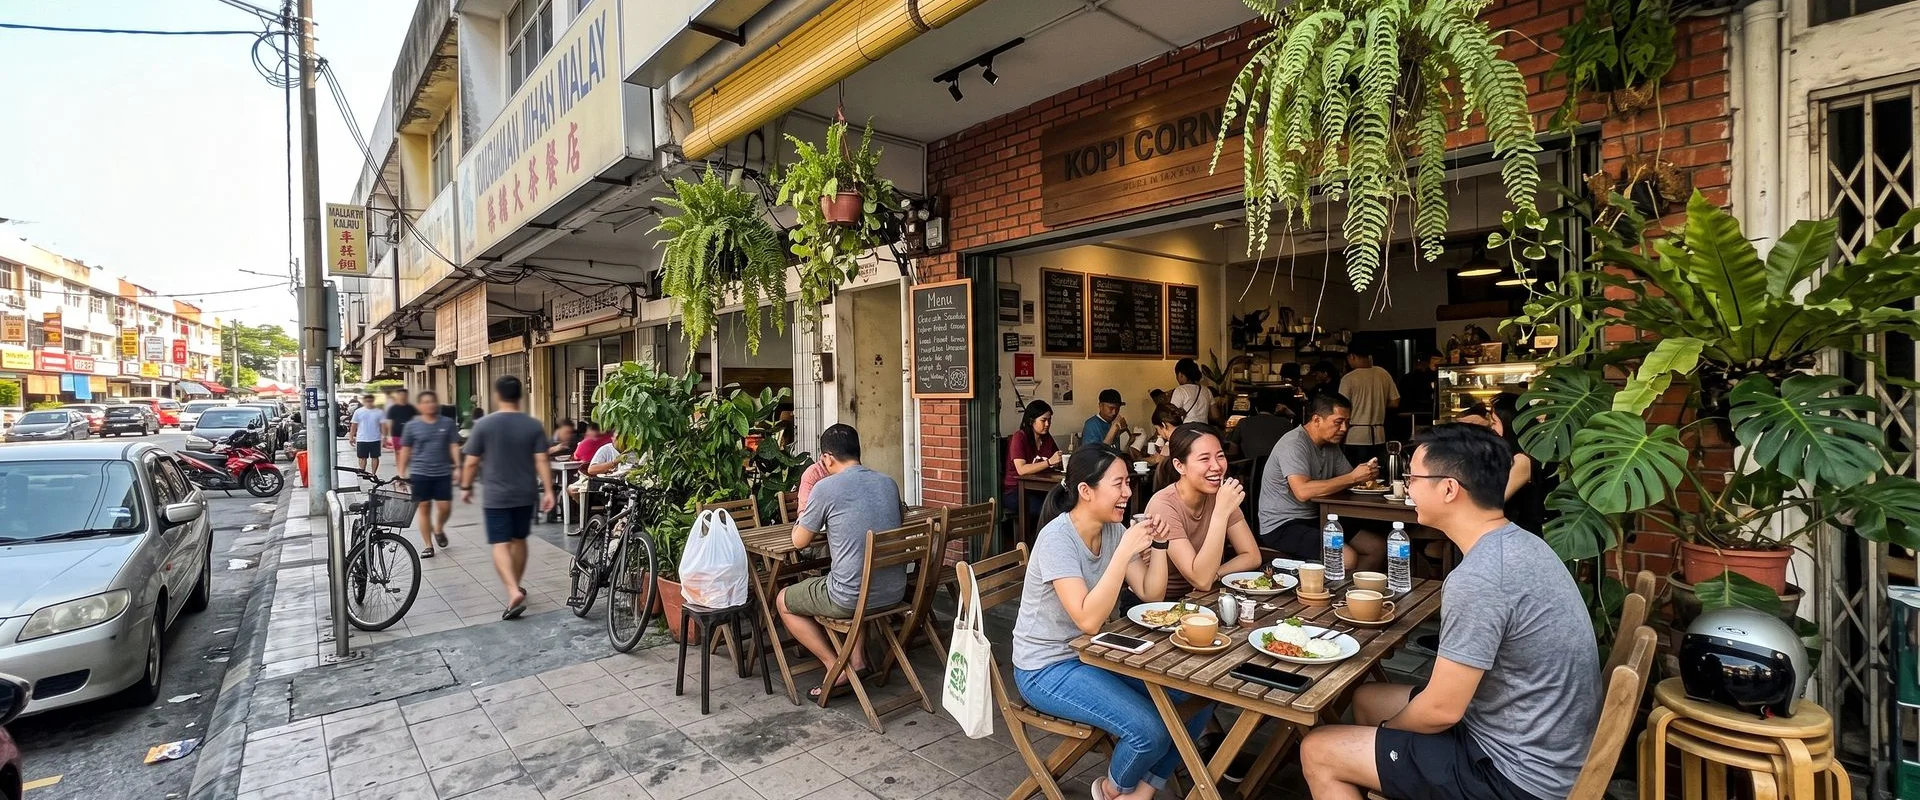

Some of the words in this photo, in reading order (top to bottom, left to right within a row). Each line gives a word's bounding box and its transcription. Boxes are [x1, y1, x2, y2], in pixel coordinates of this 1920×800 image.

[557, 9, 606, 118] MALAY
[1064, 136, 1126, 181] KOPI
[927, 292, 953, 308] Menu
